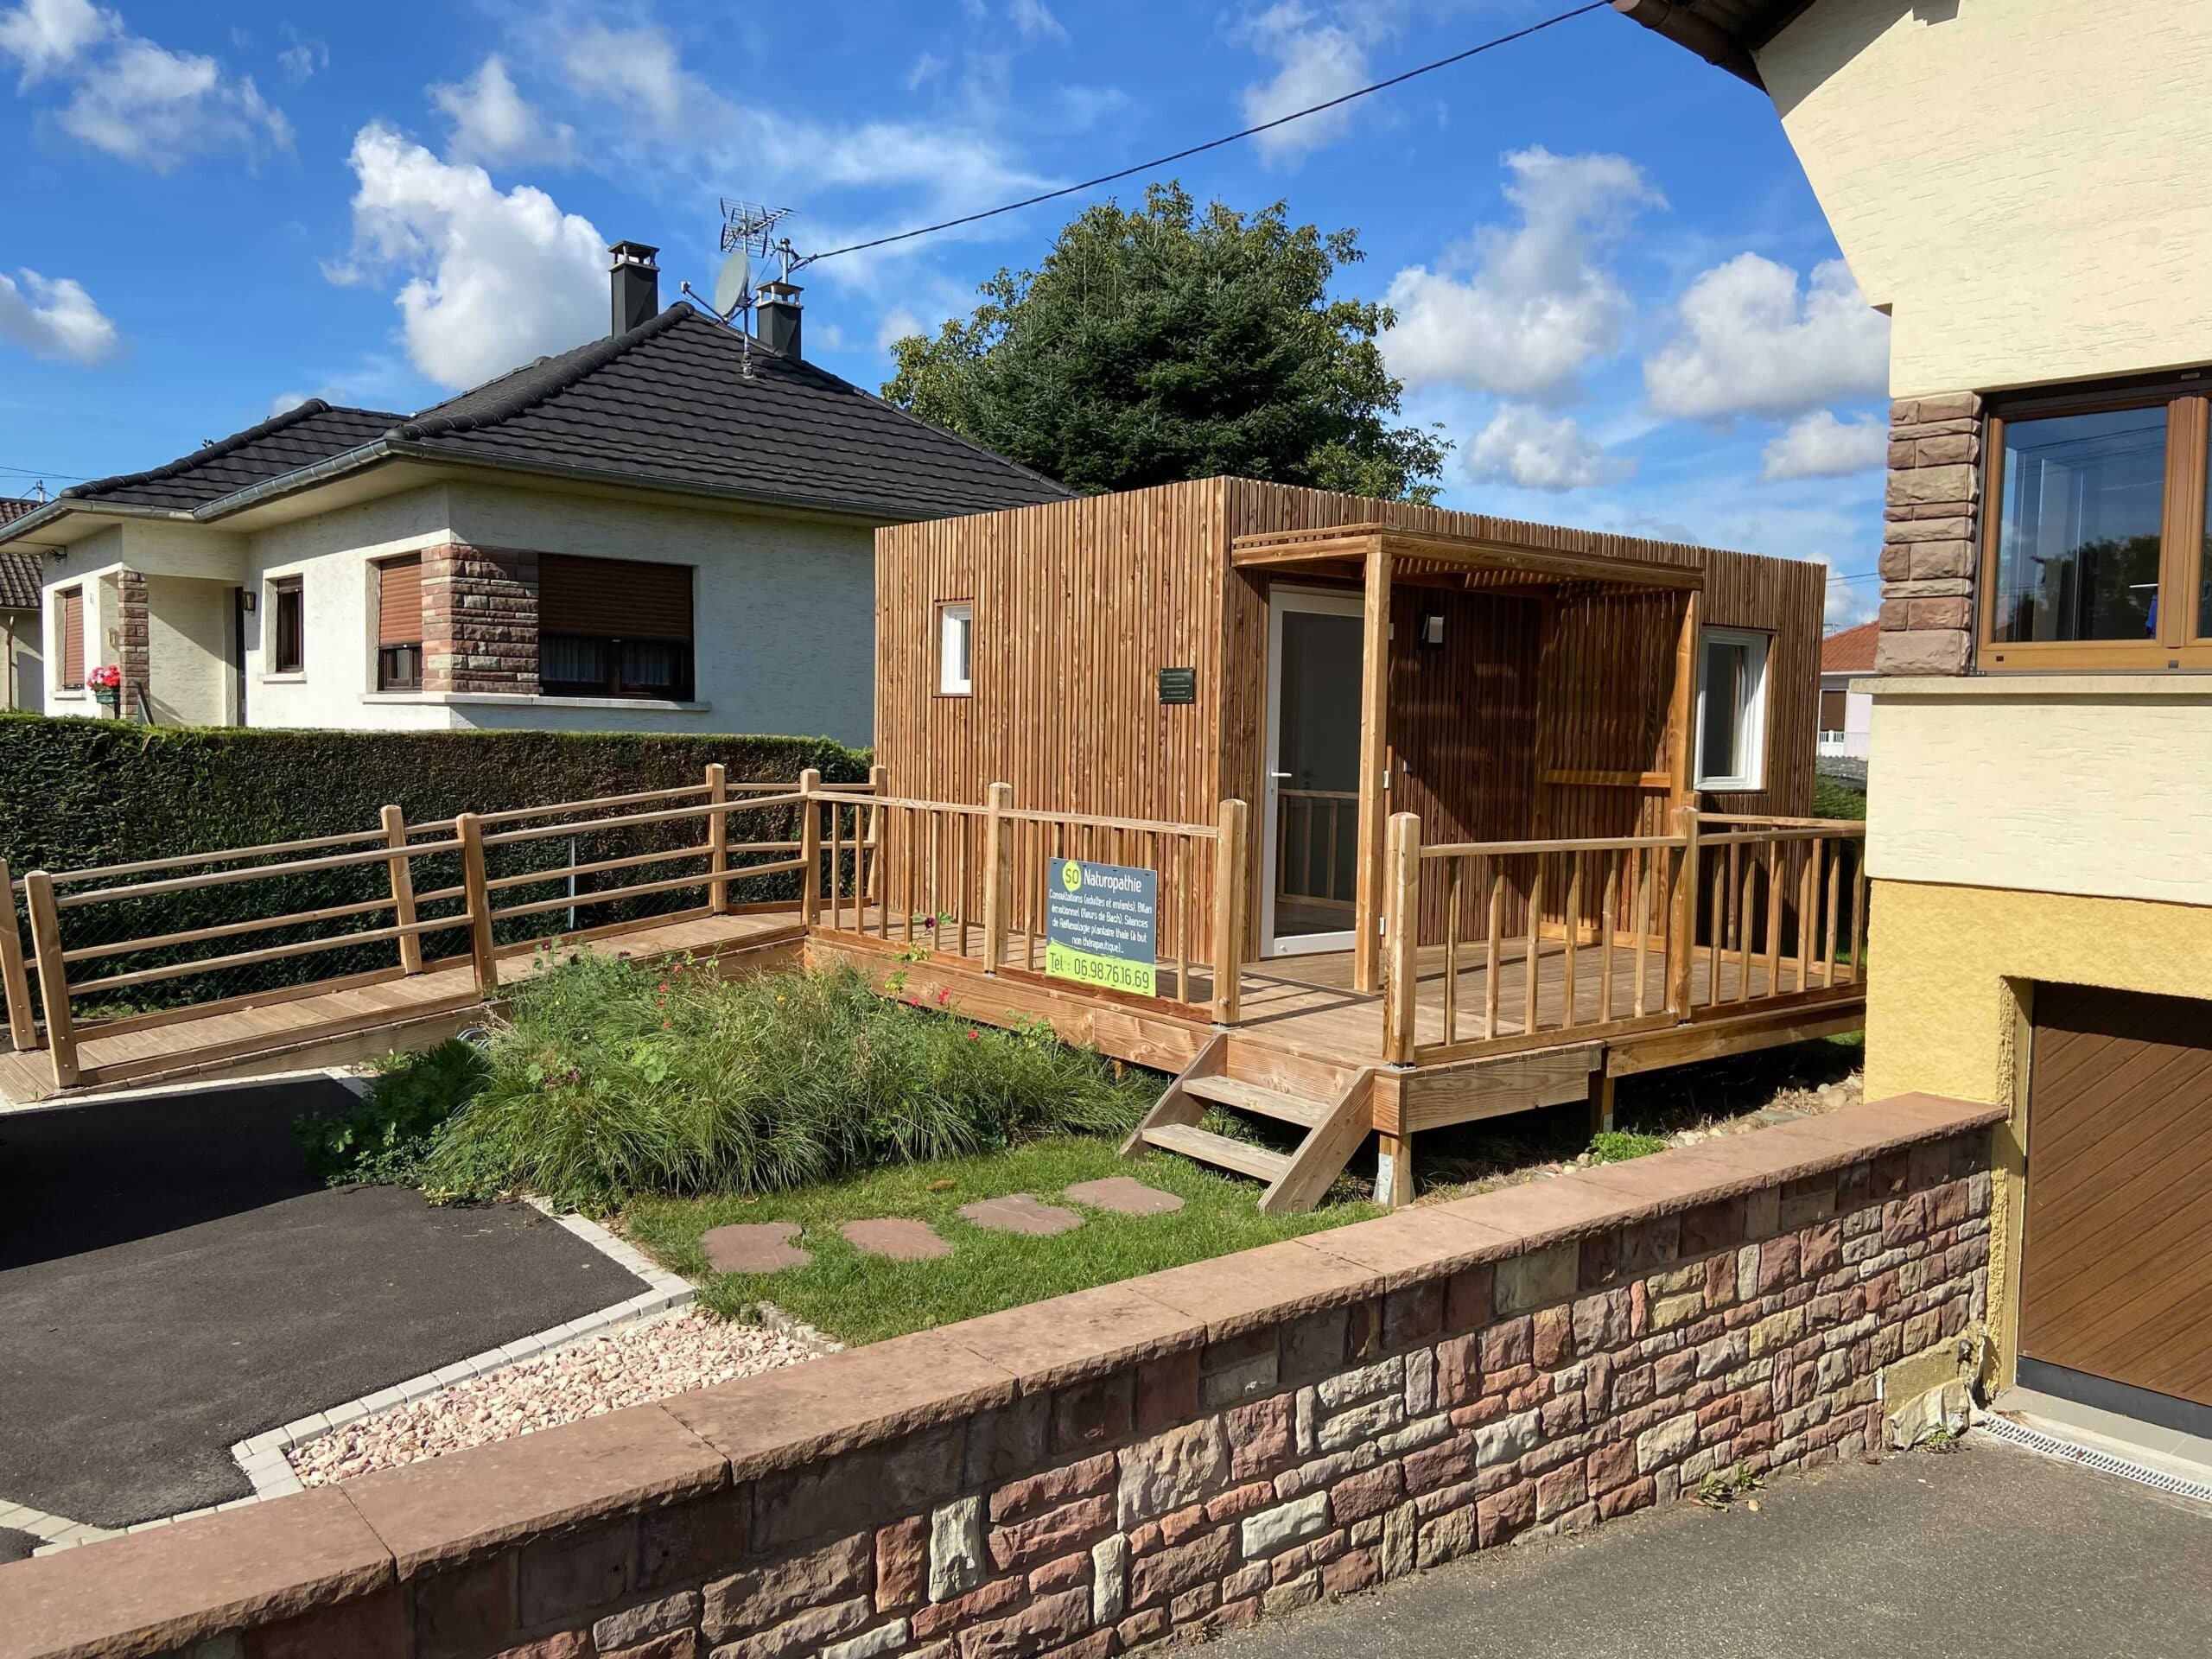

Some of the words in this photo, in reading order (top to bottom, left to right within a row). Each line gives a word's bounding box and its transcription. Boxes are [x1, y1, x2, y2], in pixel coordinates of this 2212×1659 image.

[1065, 868, 1079, 884] SO
[1084, 868, 1141, 893] Naturopathie
[1048, 888, 1084, 904] Consultations
[1106, 899, 1112, 908] et
[1137, 901, 1153, 914] Bilan
[1052, 916, 1059, 927] de
[1091, 924, 1115, 938] plantaire
[1136, 931, 1147, 944] but
[1098, 911, 1106, 921] de
[1124, 914, 1148, 929] Séances
[1071, 937, 1083, 946] non
[1074, 958, 1149, 989] 06.98.76.16.69
